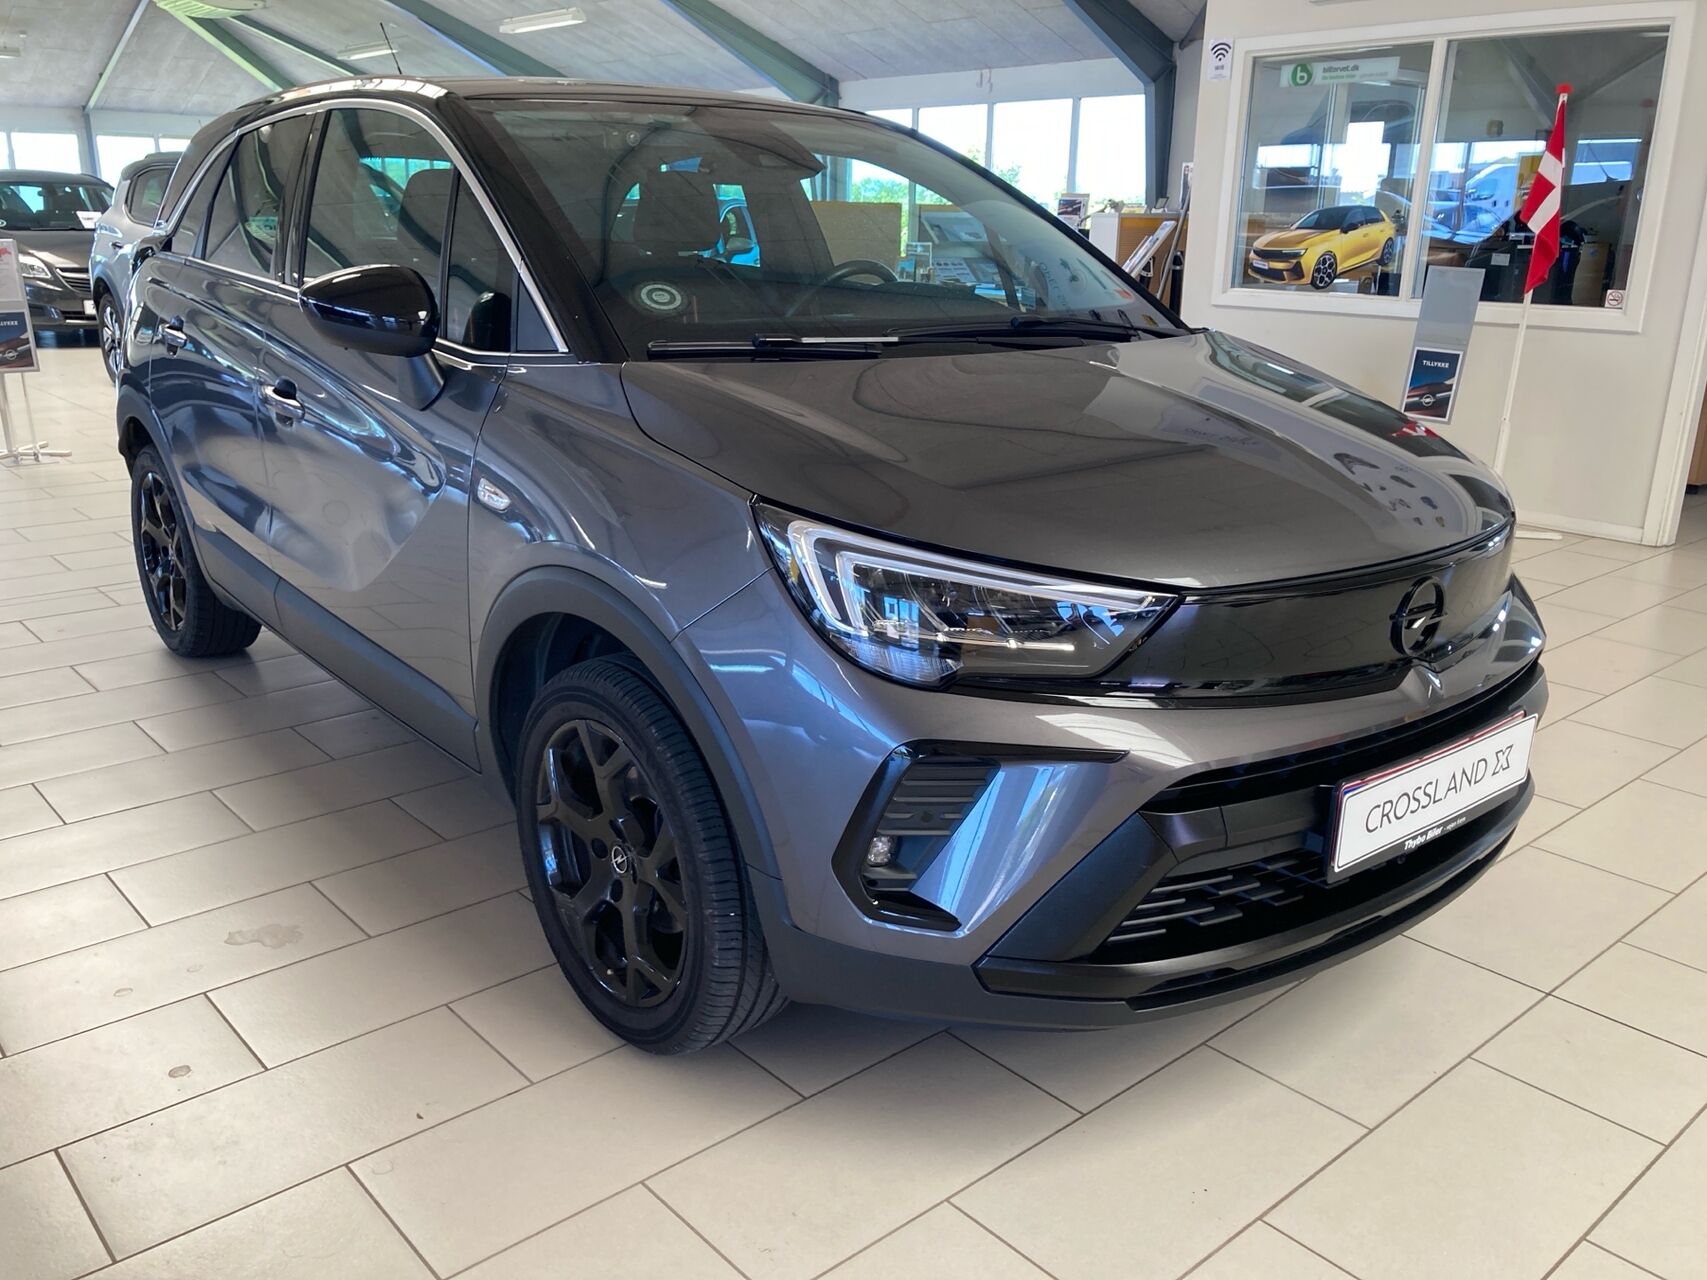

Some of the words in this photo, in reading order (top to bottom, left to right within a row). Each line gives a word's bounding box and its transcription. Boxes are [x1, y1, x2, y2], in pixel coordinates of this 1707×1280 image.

[1423, 360, 1450, 368] TILLYKKE
[1365, 757, 1488, 834] CROSSLAND
[1491, 744, 1514, 776] X
[1404, 834, 1427, 851] Thybo
[1426, 825, 1443, 840] Biler
